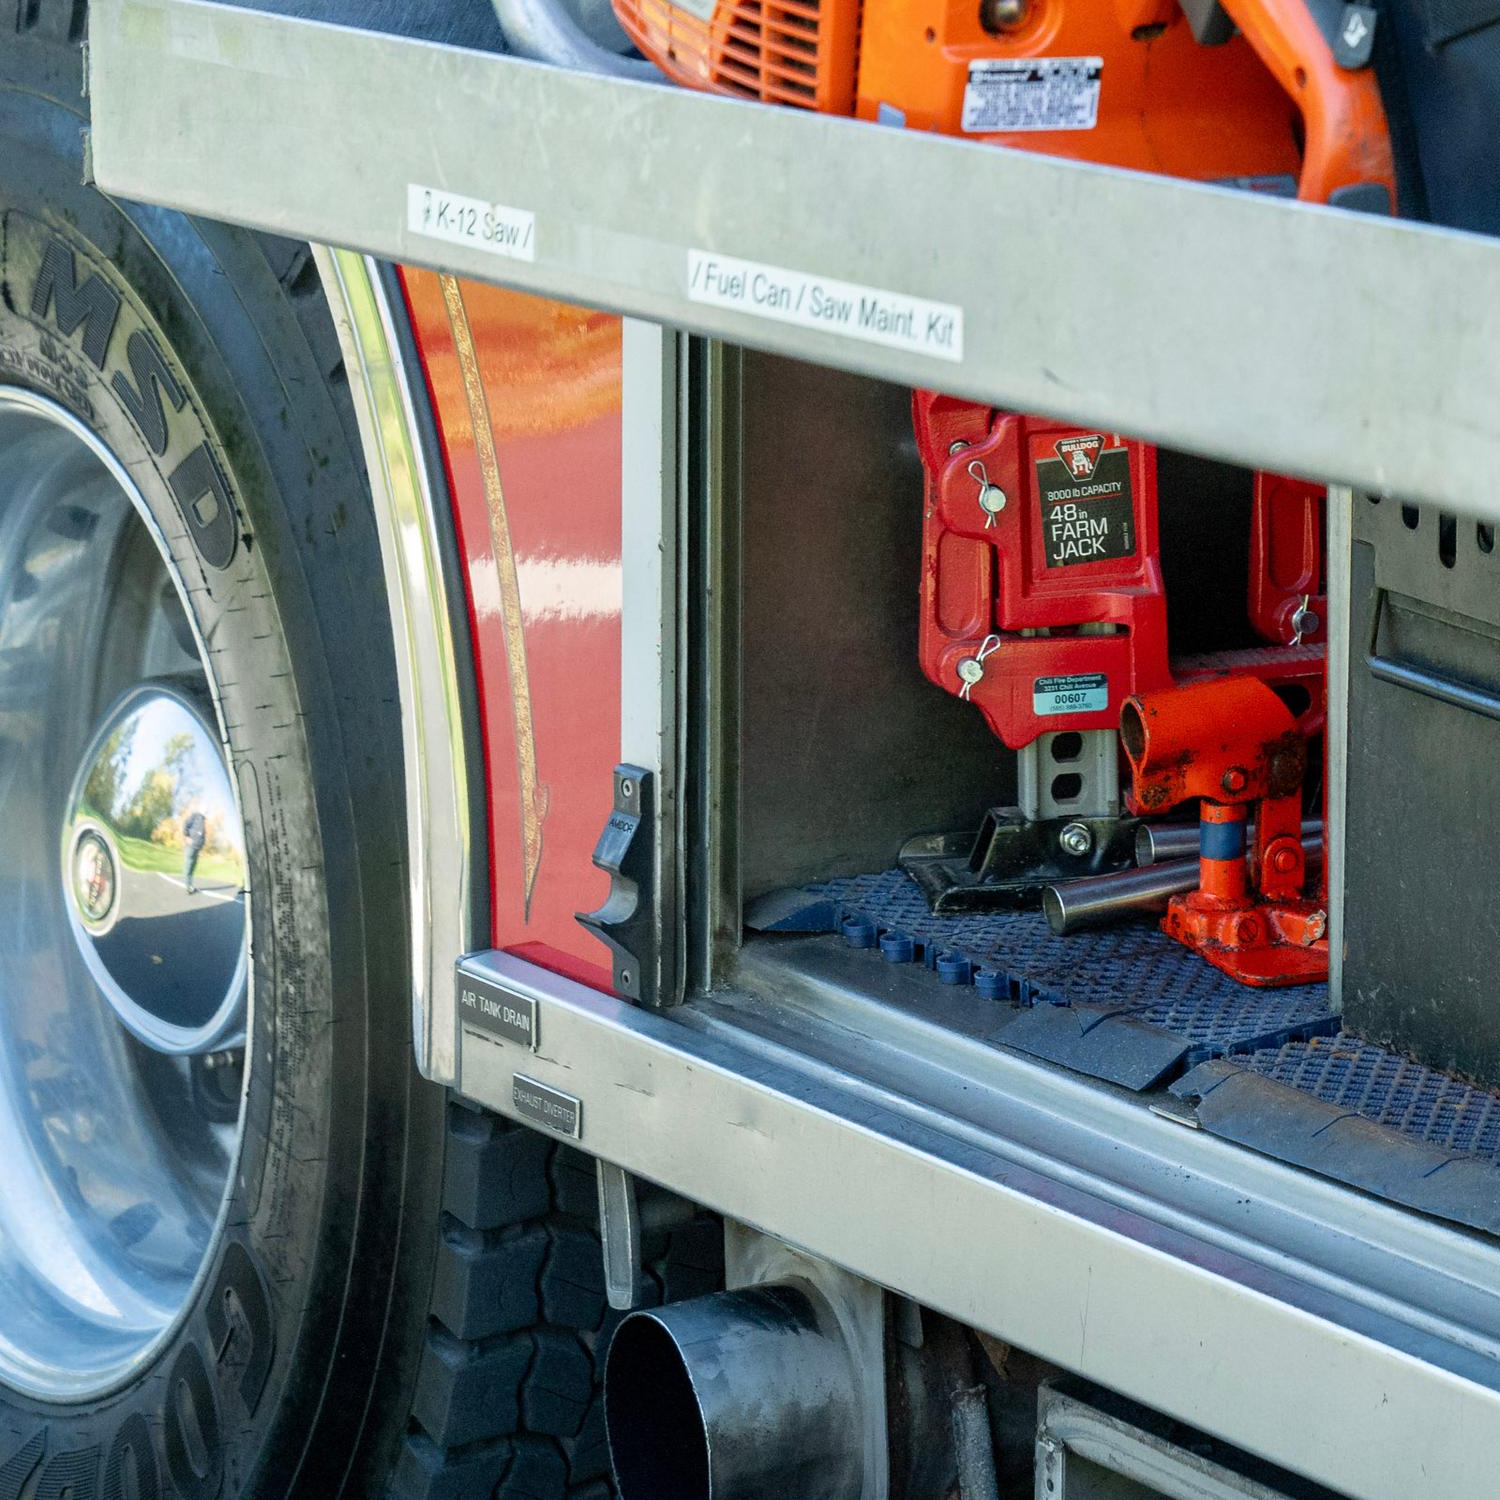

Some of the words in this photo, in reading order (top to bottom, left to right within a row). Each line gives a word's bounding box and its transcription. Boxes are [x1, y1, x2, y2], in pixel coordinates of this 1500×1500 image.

[436, 201, 477, 237] K-12
[480, 213, 521, 248] Saw
[704, 262, 748, 301] Fuel
[751, 272, 792, 311] Can
[809, 284, 854, 323] Saw
[857, 294, 919, 340] Maint.
[924, 308, 956, 348] Kit
[1046, 488, 1072, 502] 8000
[1072, 488, 1081, 498] lb
[1081, 481, 1122, 497] CAPACITY
[1049, 503, 1078, 523] 48
[1078, 508, 1089, 520] in
[1051, 516, 1109, 542] FARM
[1053, 535, 1107, 561] JACK
[1054, 692, 1088, 705] 00607
[461, 989, 478, 1010] AIR
[479, 995, 502, 1020] TANK
[503, 1006, 531, 1033] DRAIN
[512, 1086, 542, 1112] EXHAUST
[543, 1103, 576, 1125] DIVERTER
